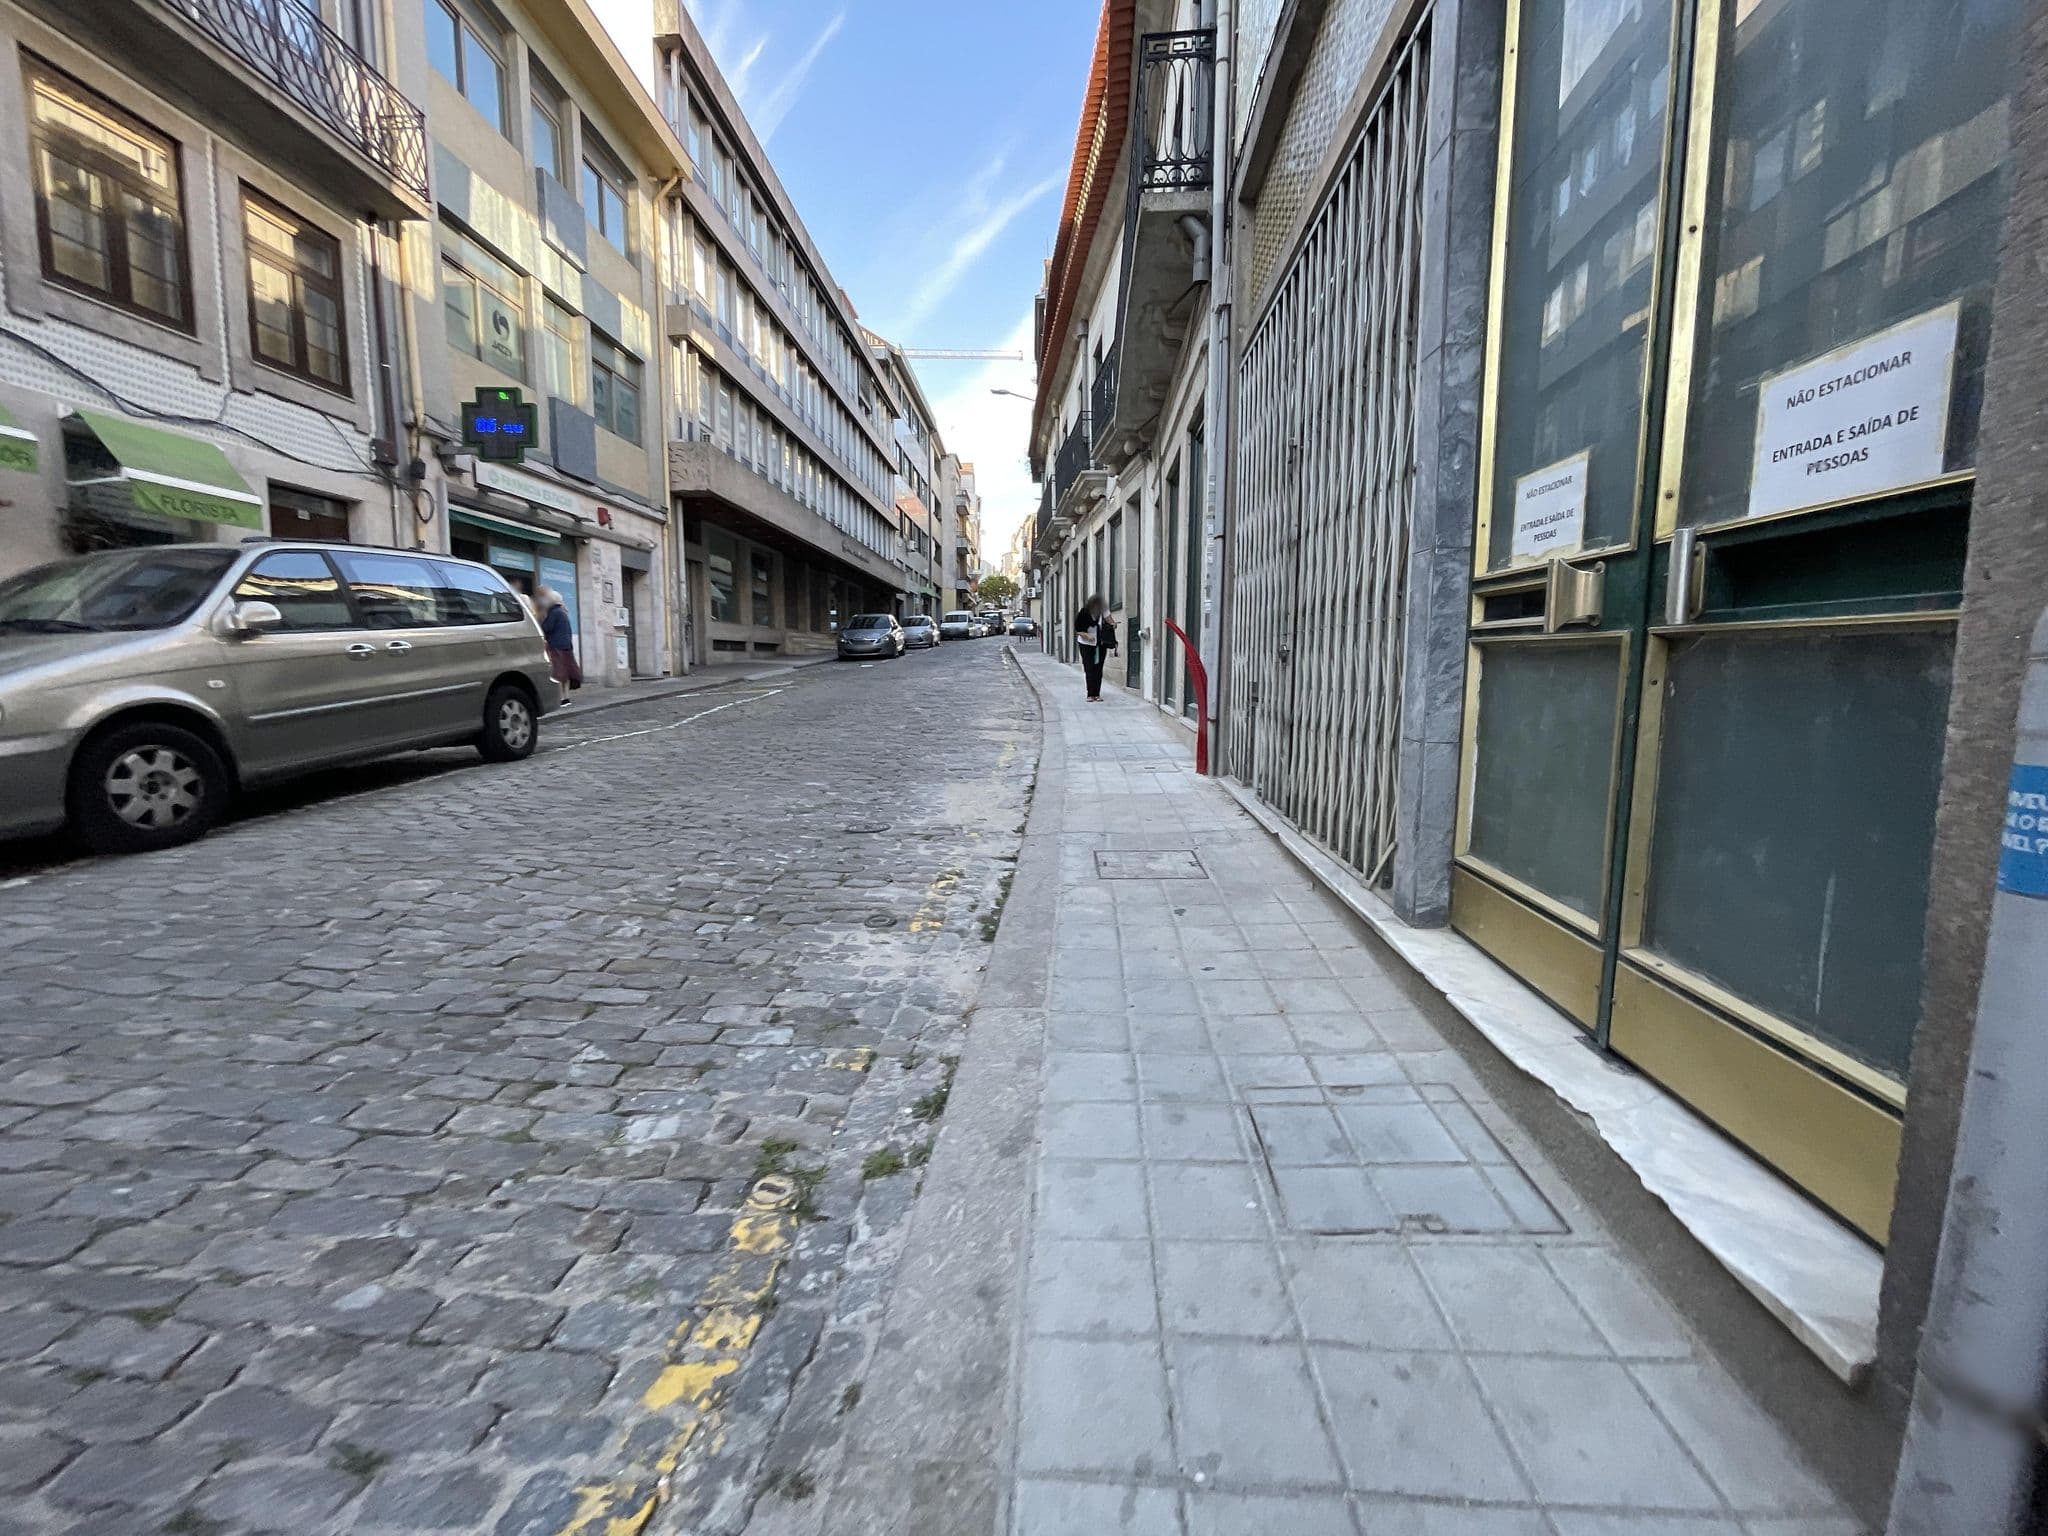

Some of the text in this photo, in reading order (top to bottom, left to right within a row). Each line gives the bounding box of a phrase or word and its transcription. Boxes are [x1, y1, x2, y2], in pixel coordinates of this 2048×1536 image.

[1786, 351, 1912, 409] NÃO ESTACIONAR
[1772, 406, 1919, 463] ENTRADA E SAÍDA DE
[1806, 447, 1869, 476] PESSOAS
[1526, 475, 1573, 500] NÃO ESTACIONAR
[160, 494, 240, 521] FLORISTA
[1520, 517, 1544, 532] ENTRADA
[1549, 511, 1566, 523] SAÍDA
[1566, 508, 1575, 518] DE
[1533, 529, 1557, 543] PESSOAS
